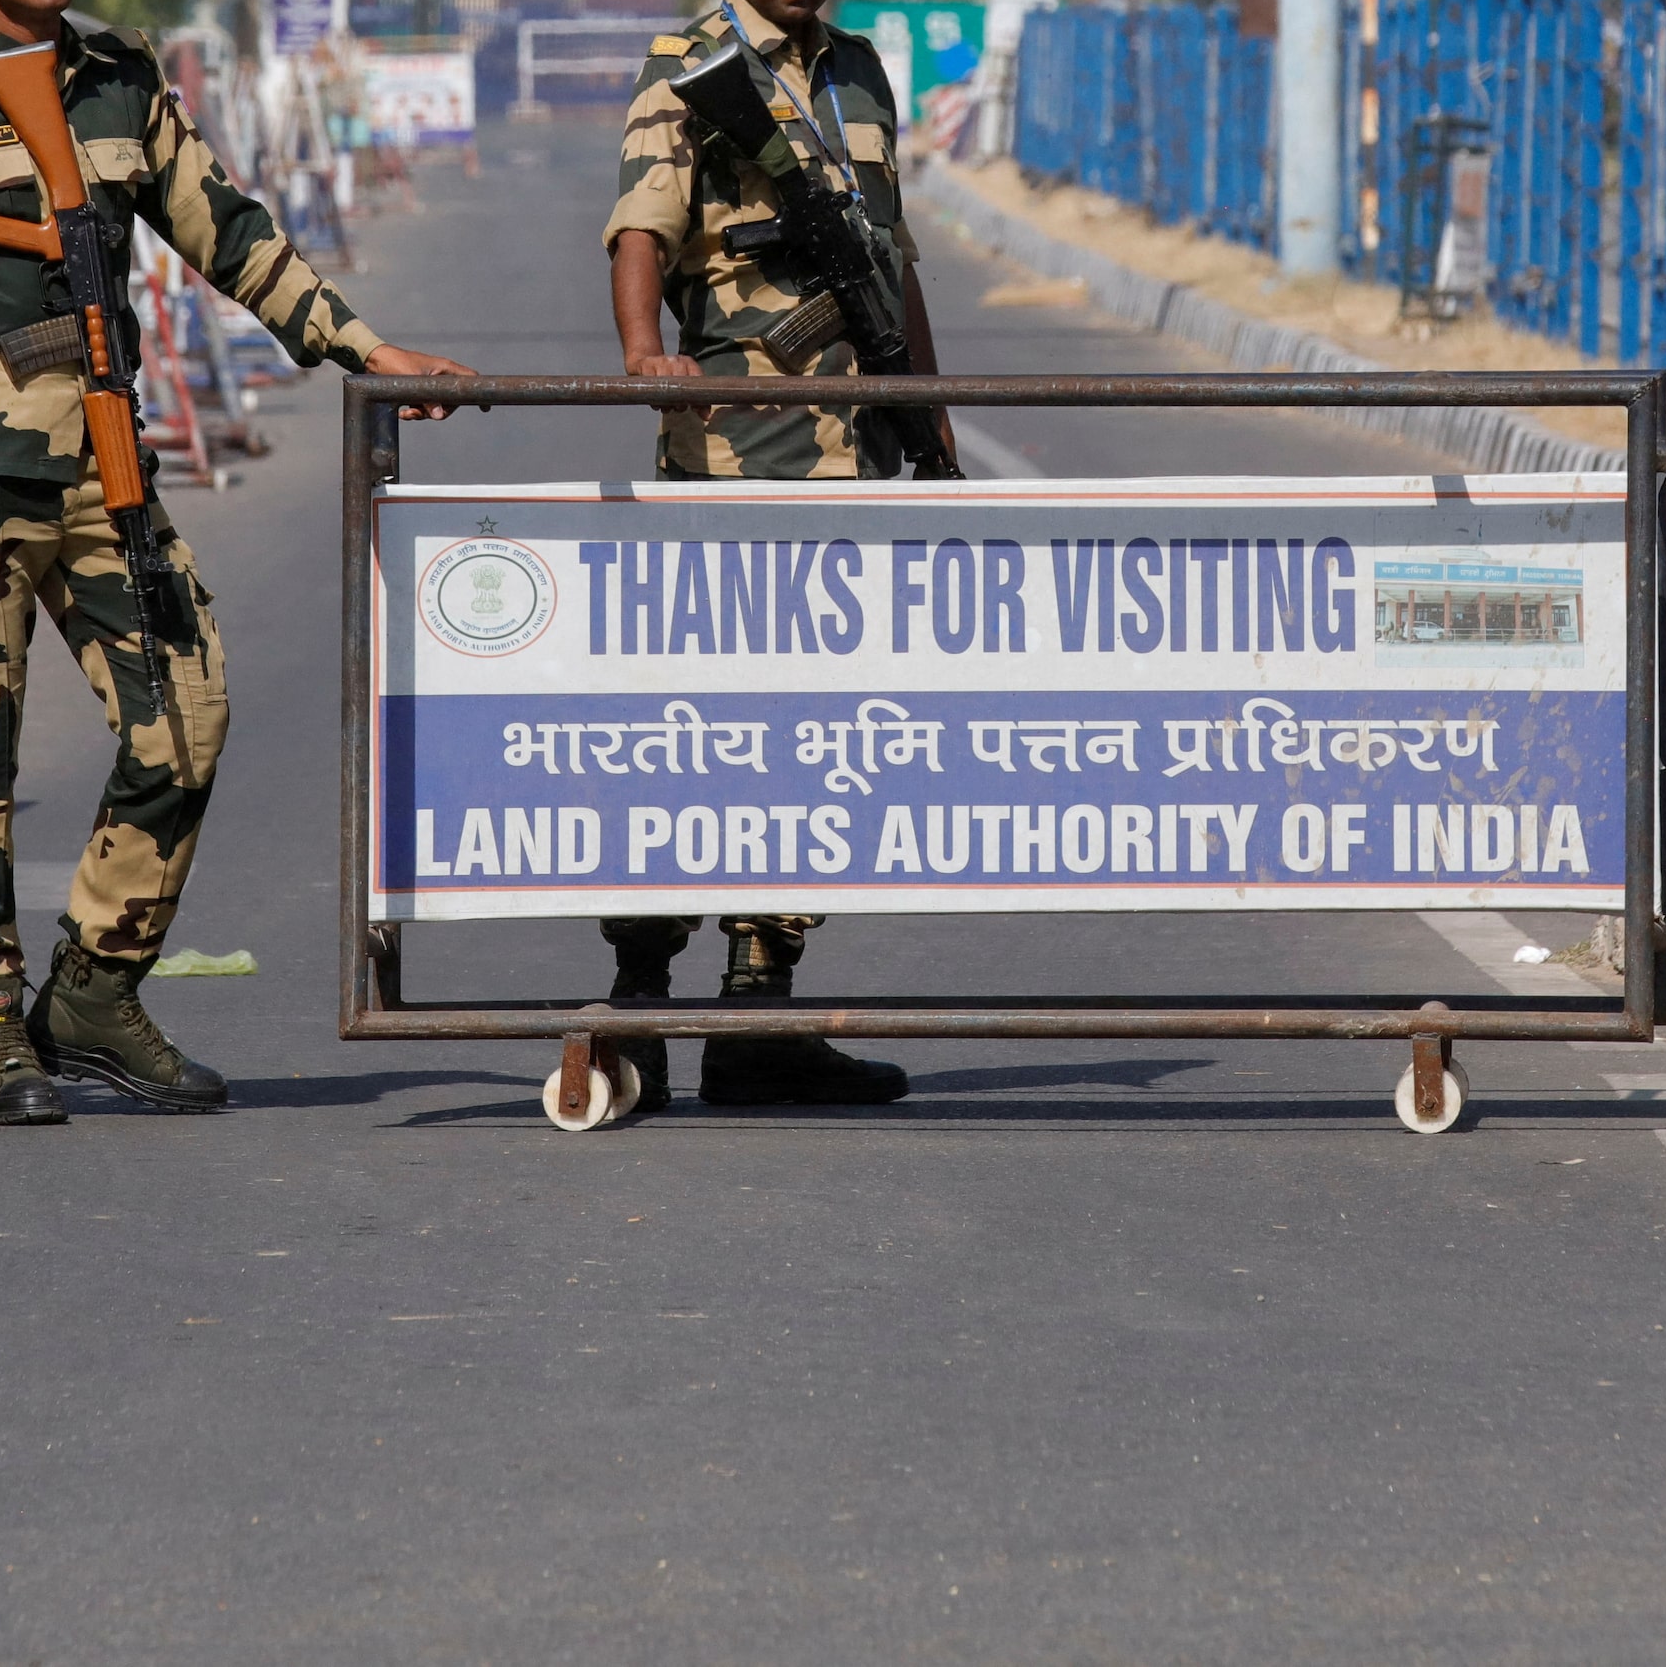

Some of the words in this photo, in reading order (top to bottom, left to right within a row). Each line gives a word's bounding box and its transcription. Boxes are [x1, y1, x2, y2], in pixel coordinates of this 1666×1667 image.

[579, 539, 863, 656] THANKS
[891, 538, 1026, 654] FOR
[1049, 536, 1357, 654] VISITING
[441, 629, 468, 648] PORTS
[470, 637, 521, 652] AUTHORITY
[503, 700, 770, 774] भारतीय
[795, 698, 946, 796] भूमि
[968, 718, 1141, 774] पत्तन
[1163, 697, 1500, 779] प्राधिकरण
[416, 807, 601, 876] LAND
[628, 803, 851, 875] PORTS
[874, 804, 1259, 874] AUTHORITY
[1281, 803, 1366, 874] OF
[1393, 804, 1590, 874] INDIA
